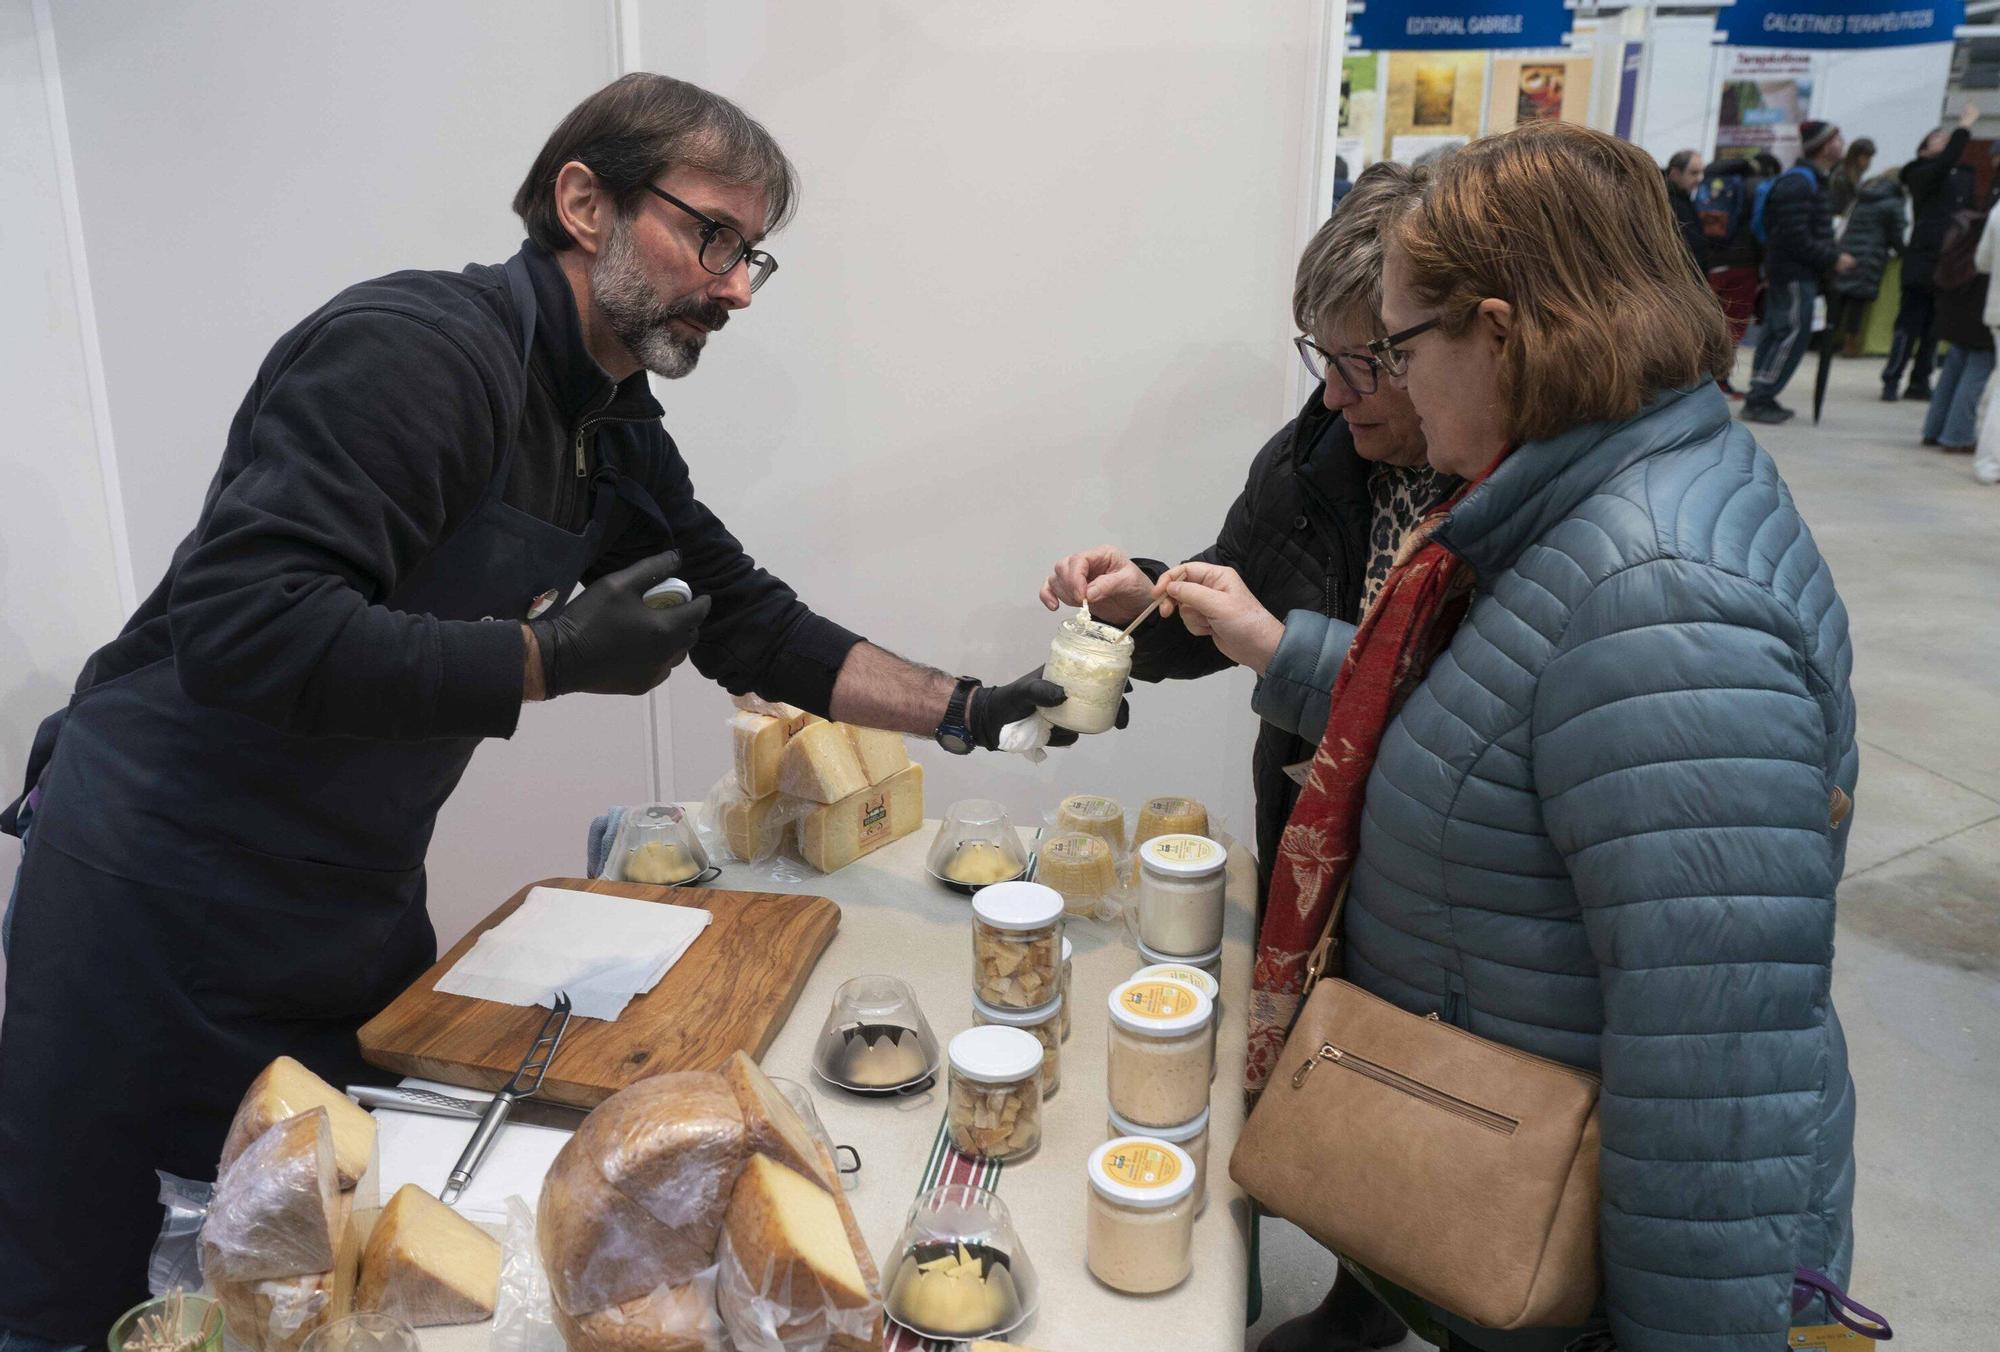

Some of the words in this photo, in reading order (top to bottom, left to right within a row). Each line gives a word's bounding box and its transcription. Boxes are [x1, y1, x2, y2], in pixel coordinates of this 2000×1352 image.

[1406, 16, 1465, 35] EDITORIAL
[1467, 14, 1523, 34] GABRIELE
[1763, 12, 1844, 34] CALCETINES
